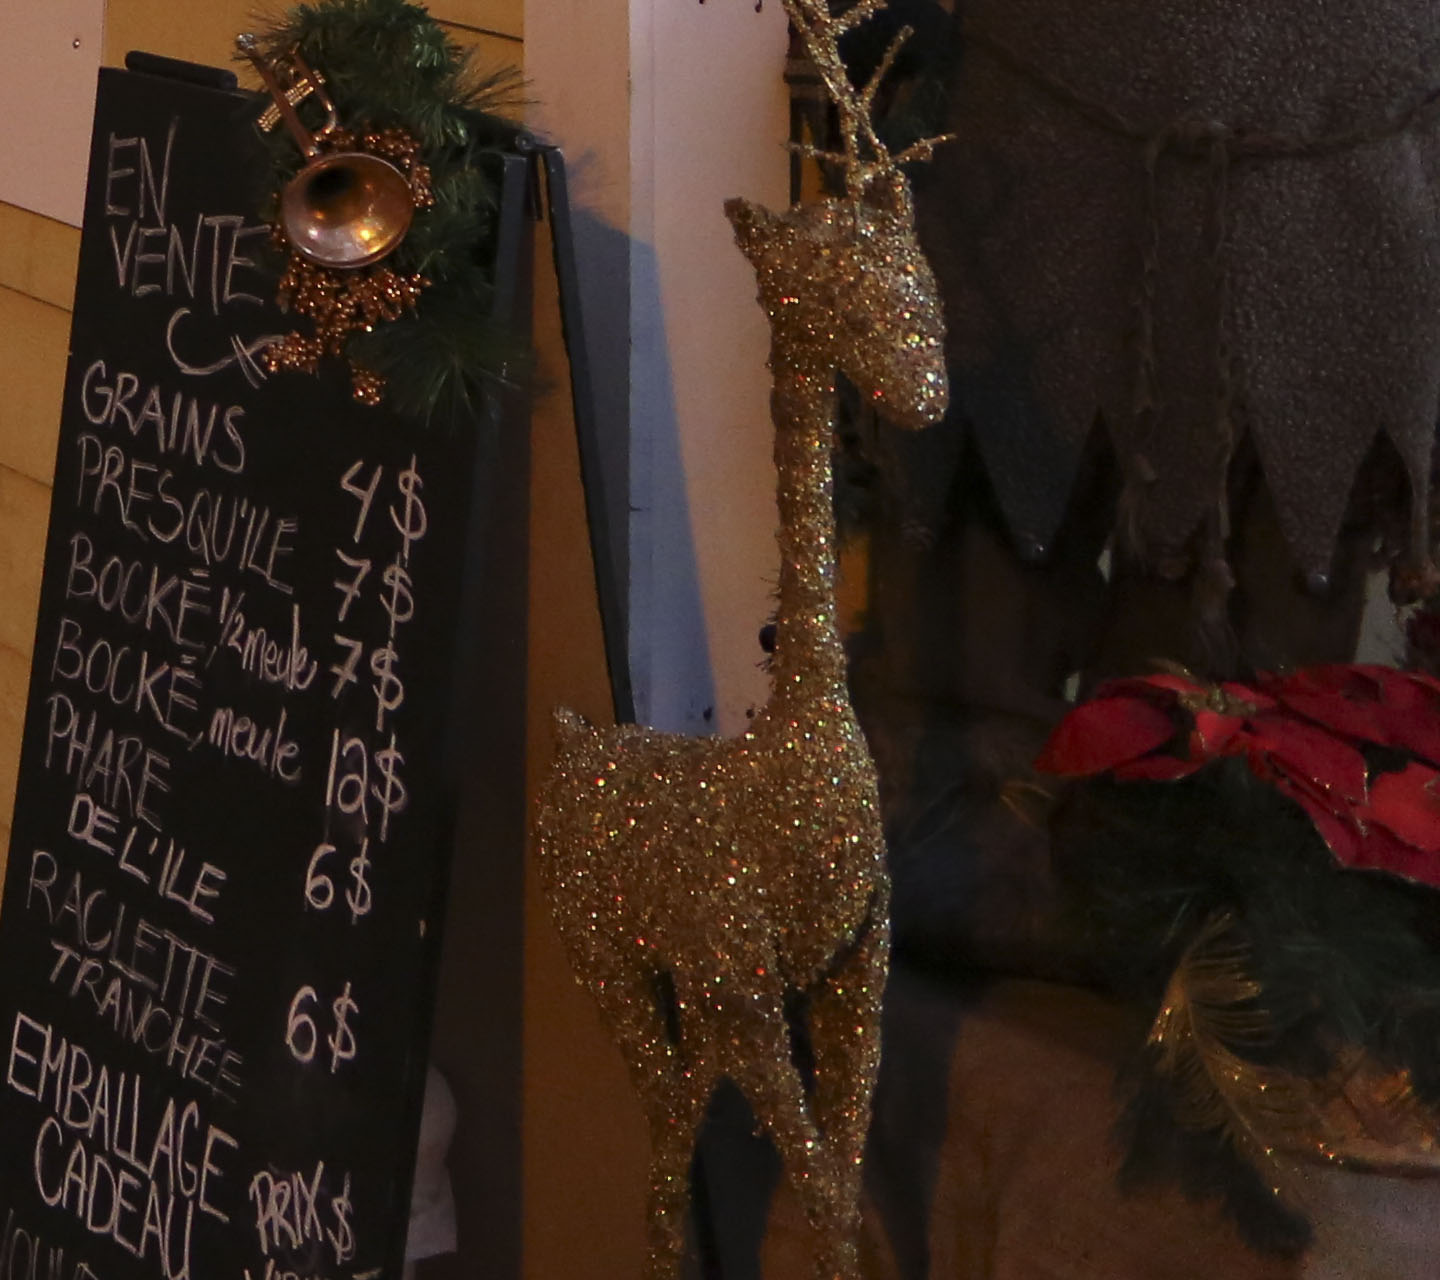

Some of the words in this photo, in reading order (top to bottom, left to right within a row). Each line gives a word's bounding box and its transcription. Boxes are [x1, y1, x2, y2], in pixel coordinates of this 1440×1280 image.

[104, 114, 180, 229] EN
[109, 212, 274, 317] VENTE
[81, 359, 247, 475] GRAINS
[44, 693, 171, 833] PHARE
[208, 704, 304, 782] meule
[67, 792, 121, 857] DE
[26, 847, 237, 1034] RACLETTE
[6, 1010, 240, 1224] EMBALLAGE
[33, 1115, 196, 1280] CADEAU
